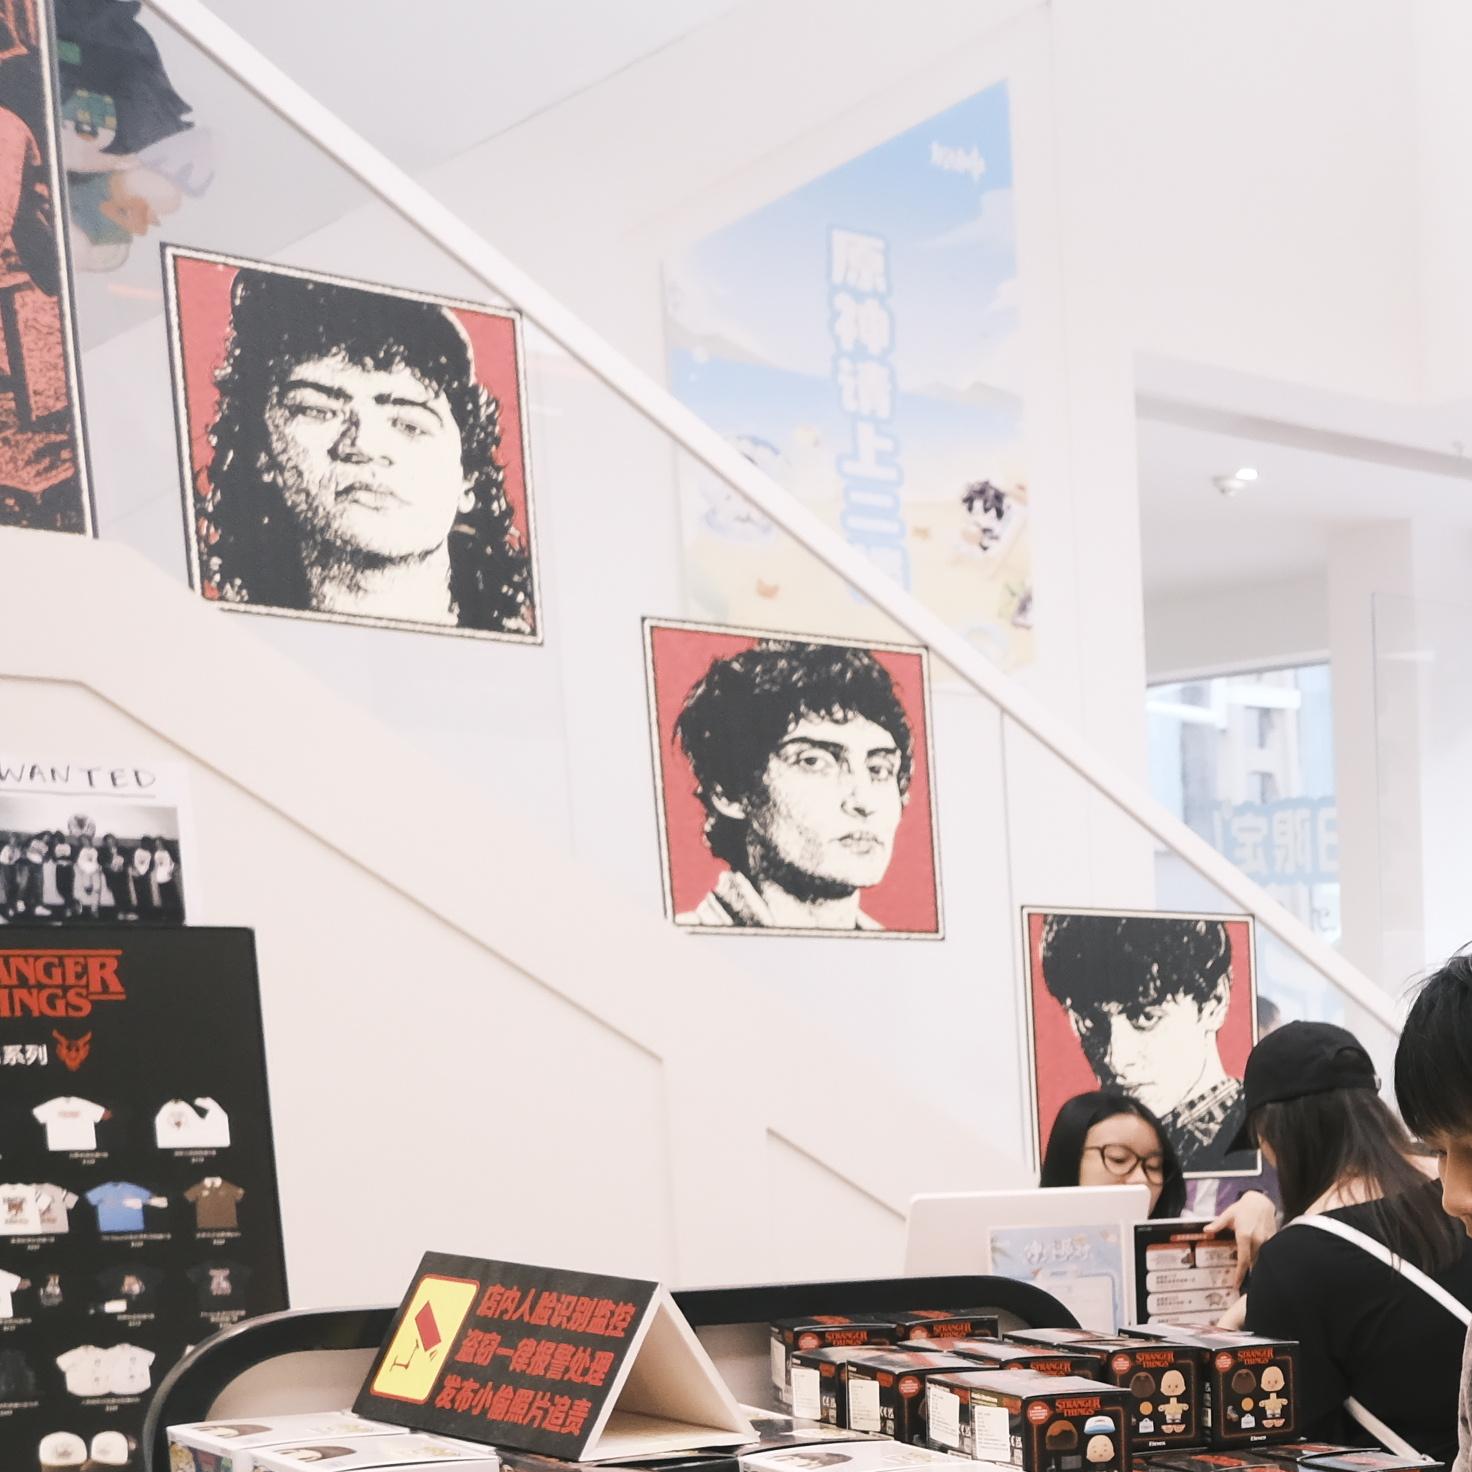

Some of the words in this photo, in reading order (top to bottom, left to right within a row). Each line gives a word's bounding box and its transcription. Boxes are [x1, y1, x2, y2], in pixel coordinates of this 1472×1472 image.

[830, 228, 908, 600] 原神请上二
[0, 763, 156, 788] WANTED
[476, 1284, 636, 1338] 店内人脸识别监控
[454, 1329, 615, 1386] 盗窃一律报警处理
[1136, 1351, 1174, 1363] STRANGER
[1238, 1347, 1273, 1360] STRANGER
[435, 1374, 592, 1436] 发布小偷照片追责
[1056, 1397, 1102, 1410] STRANGER
[1063, 1407, 1096, 1417] THINGS
